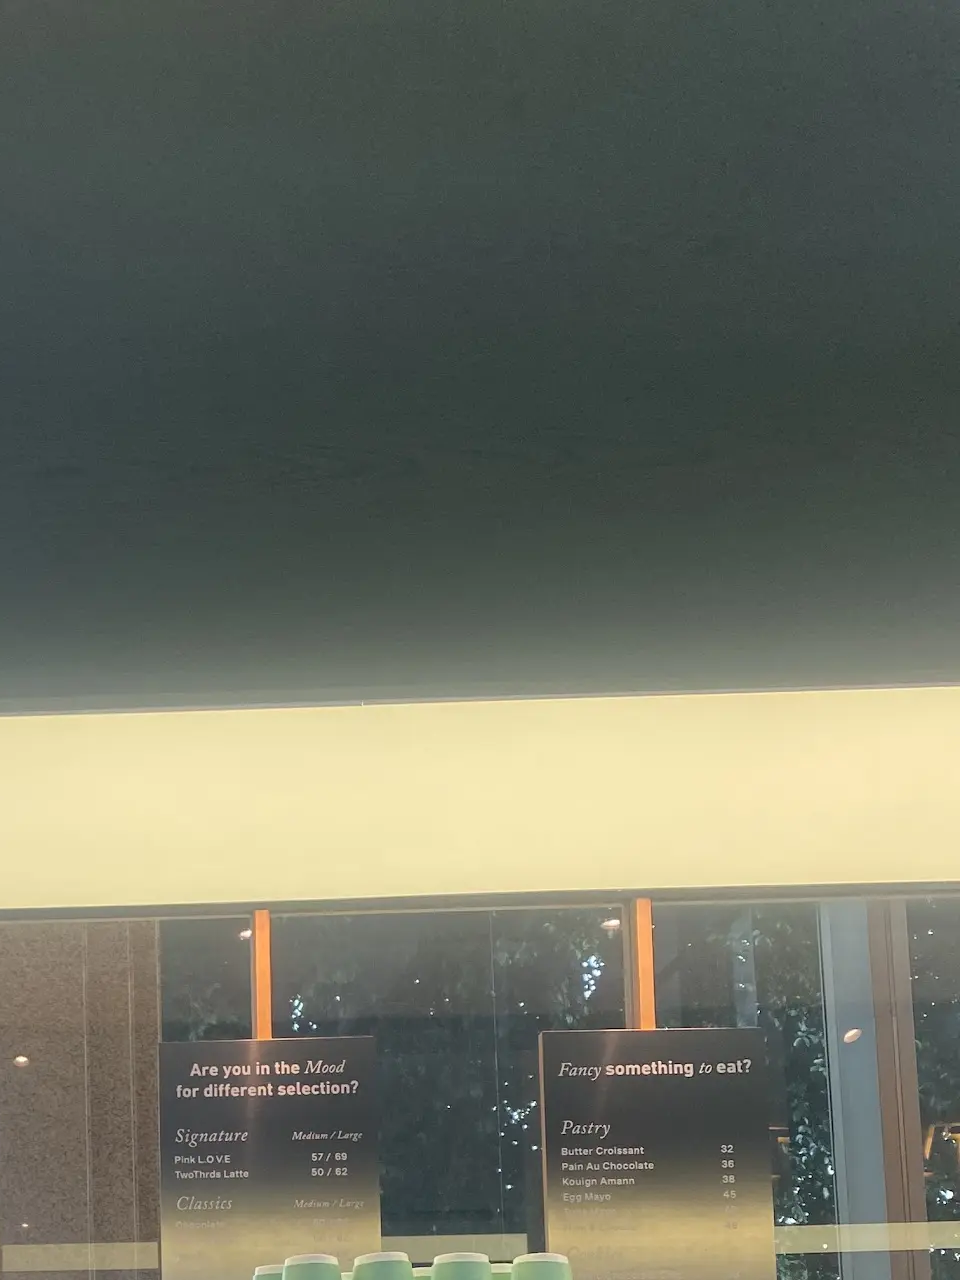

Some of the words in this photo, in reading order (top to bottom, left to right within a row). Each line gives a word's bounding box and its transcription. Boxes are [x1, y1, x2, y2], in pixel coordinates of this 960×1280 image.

[190, 1063, 218, 1077] Are
[223, 1064, 251, 1079] you
[256, 1062, 270, 1075] in
[274, 1061, 300, 1075] the
[304, 1060, 346, 1074] Mood
[558, 1062, 601, 1081] Fancy
[605, 1060, 693, 1077] something
[699, 1063, 712, 1074] to
[717, 1059, 752, 1074] eat?
[176, 1085, 199, 1098] for
[204, 1083, 273, 1098] different
[278, 1080, 359, 1096] selection?
[561, 1120, 610, 1139] Pastry
[175, 1129, 248, 1148] Signature
[292, 1131, 328, 1140] Medium
[338, 1131, 362, 1142] Large
[561, 1147, 593, 1156] Butter
[596, 1146, 644, 1156] Croissant
[721, 1145, 734, 1154] 32
[174, 1156, 195, 1164] Pink
[311, 1153, 323, 1161] 57
[335, 1153, 347, 1161] 69
[562, 1162, 583, 1171] Pain
[586, 1162, 600, 1170] Au
[602, 1161, 654, 1170] Chocolate
[721, 1160, 734, 1169] 36
[175, 1171, 221, 1179] TwoThrds
[224, 1170, 249, 1179] Latte
[311, 1168, 324, 1176] 50
[335, 1168, 348, 1176] 62
[562, 1177, 597, 1188] Kouign
[600, 1177, 635, 1186] Amann
[722, 1175, 735, 1184] 38
[563, 1193, 581, 1202] Egg
[584, 1192, 611, 1201] Mayo
[723, 1190, 736, 1199] 45
[177, 1196, 232, 1211] Classics
[293, 1199, 329, 1209] Medium
[339, 1199, 364, 1209] Large
